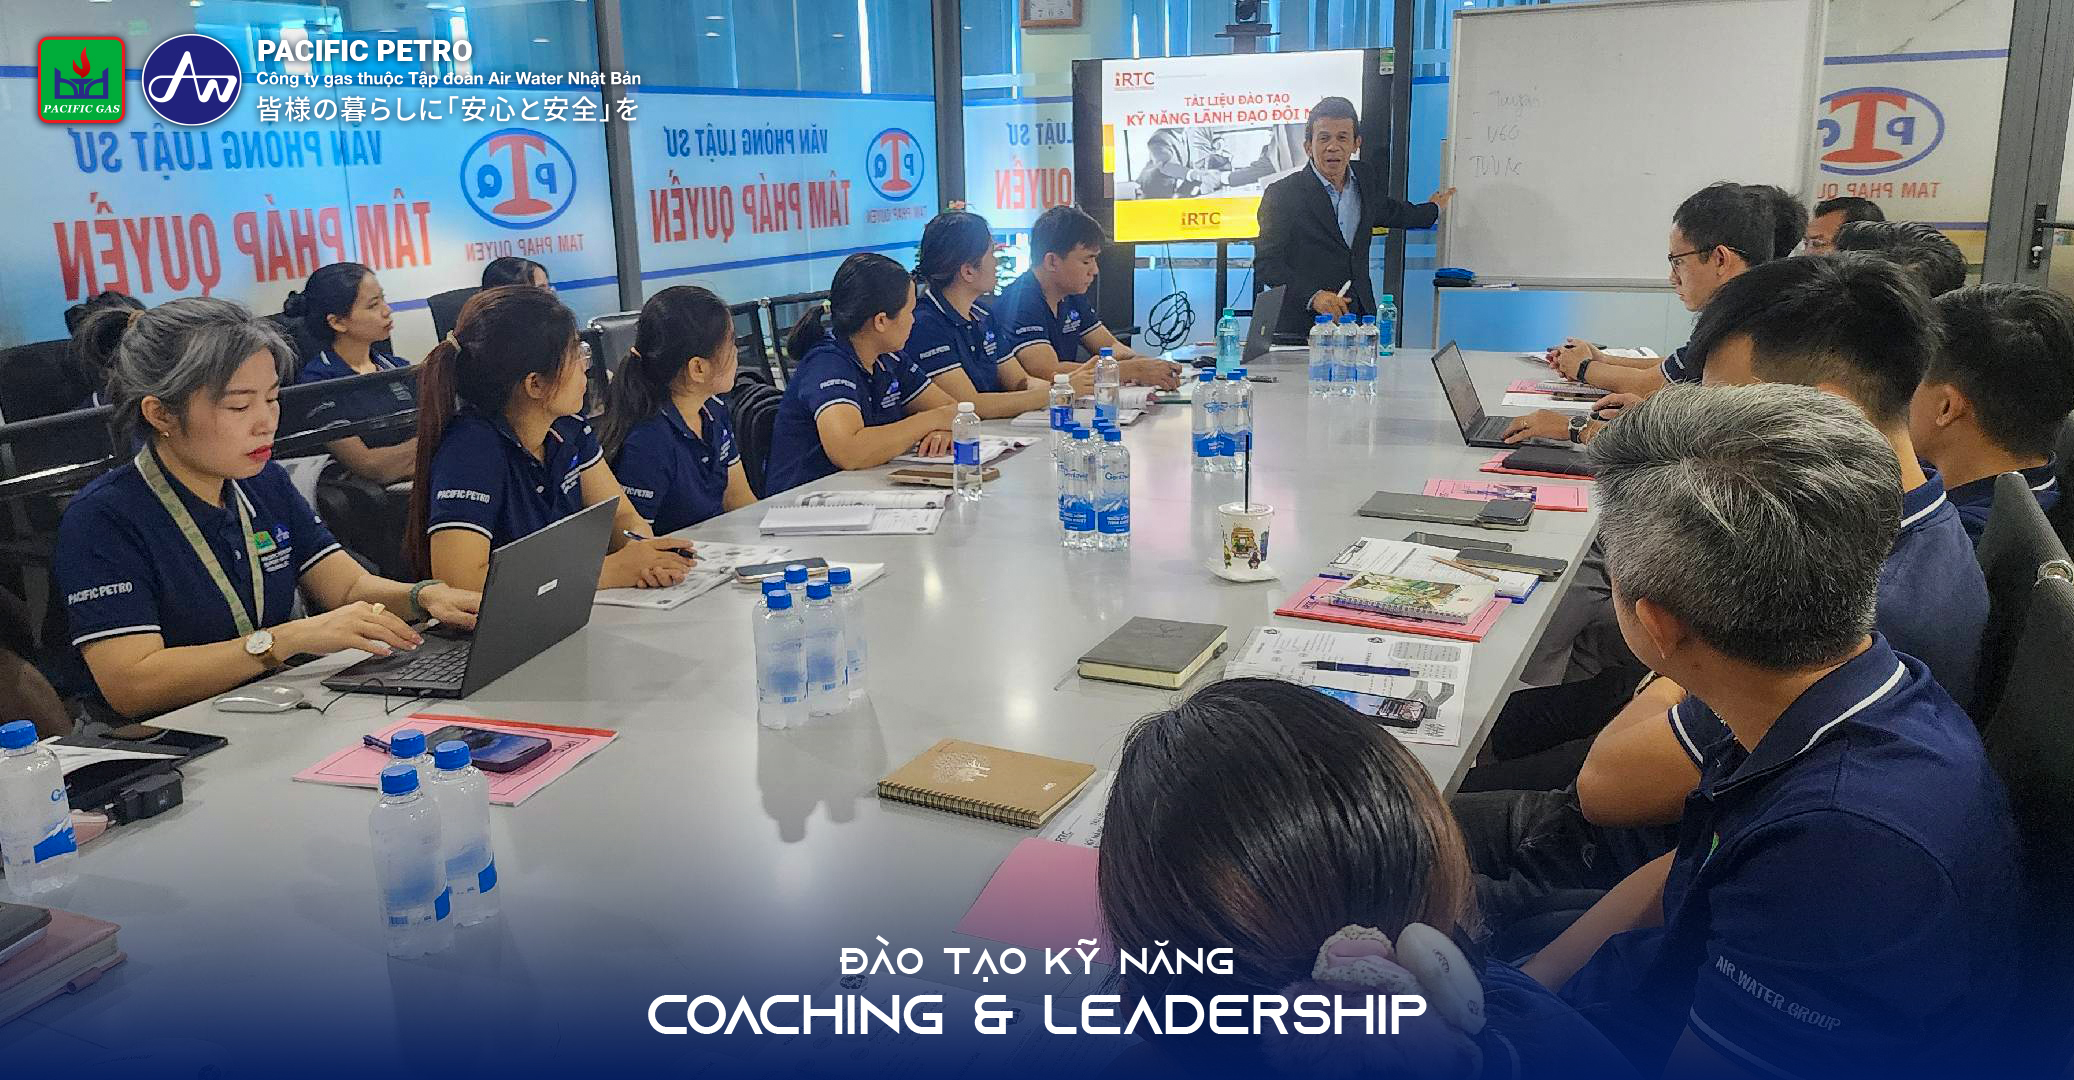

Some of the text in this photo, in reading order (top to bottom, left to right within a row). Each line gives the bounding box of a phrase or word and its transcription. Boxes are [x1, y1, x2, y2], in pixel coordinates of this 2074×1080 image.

[1207, 92, 1235, 108] LIỆU
[1267, 93, 1290, 106] TẠO
[1149, 110, 1190, 126] NĂNG
[1194, 108, 1233, 124] LÃNH
[1237, 109, 1268, 125] ĐẠO
[99, 581, 133, 597] PETRO
[1715, 955, 1841, 1031] AIR WATER GROUP
